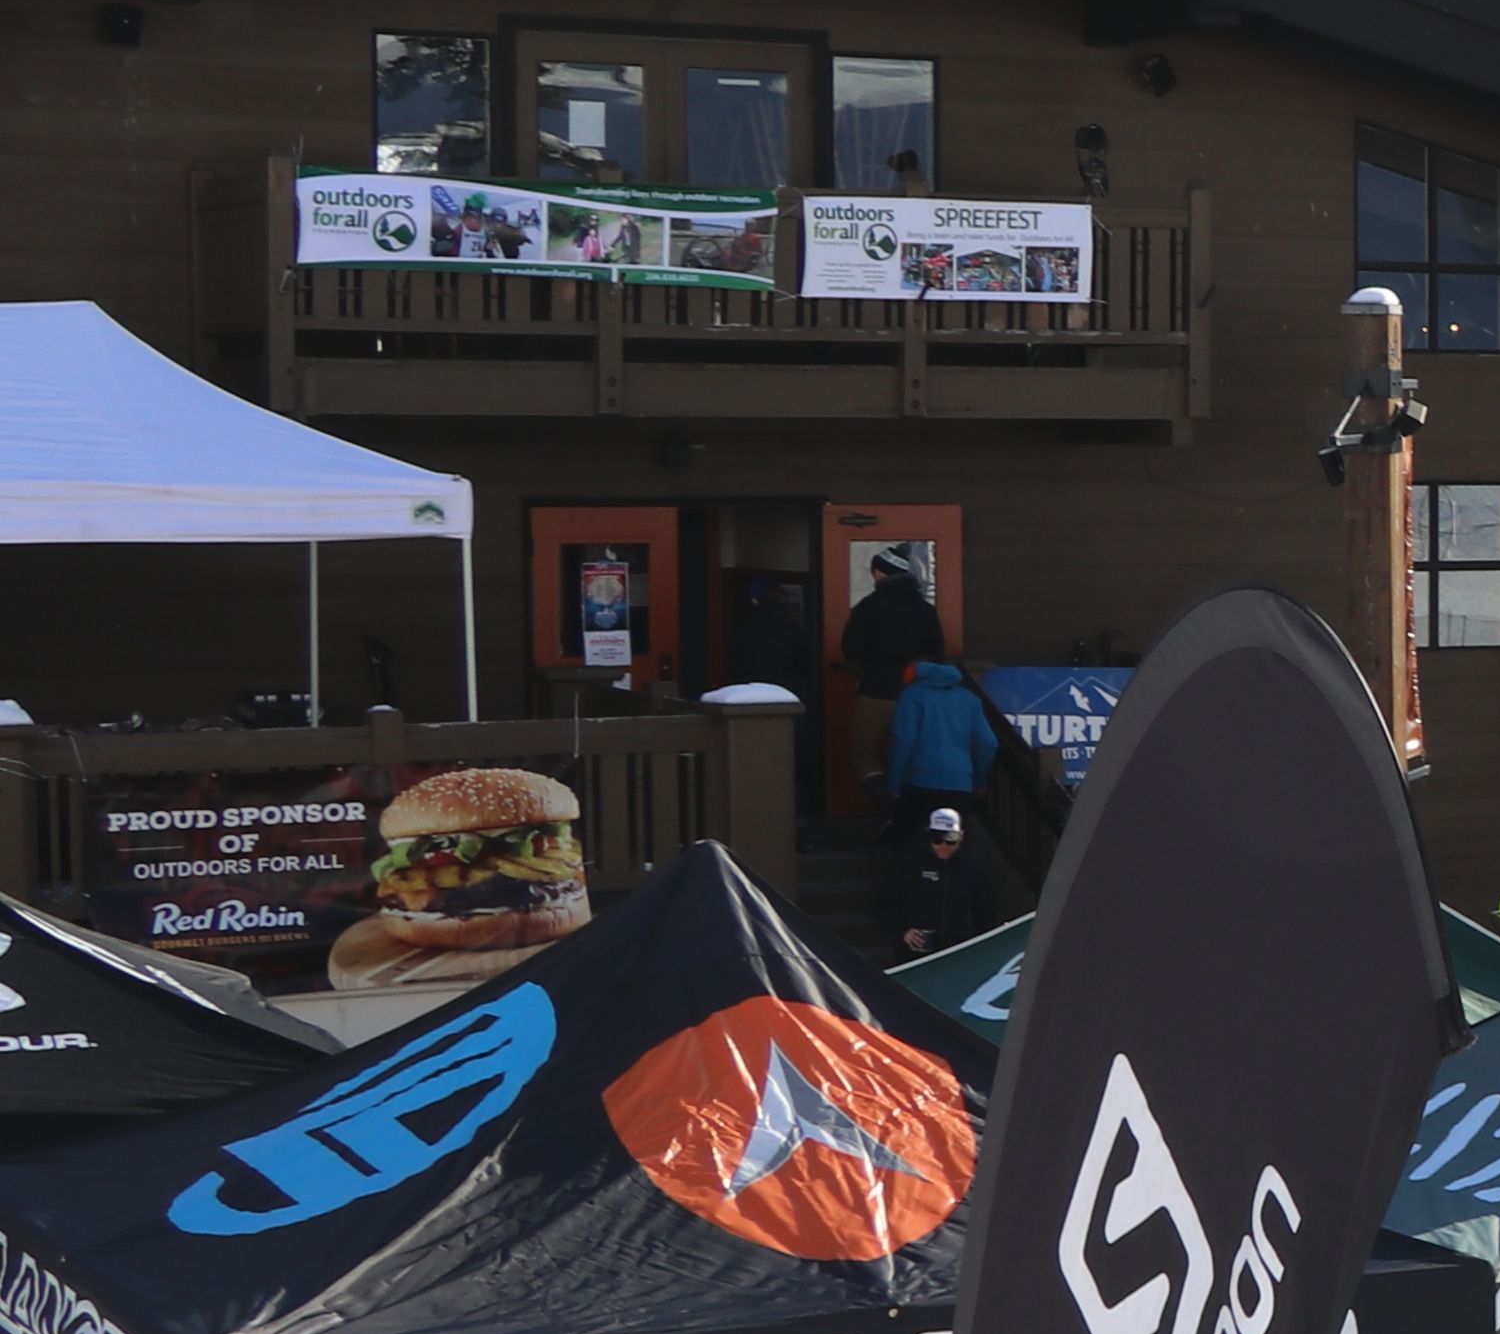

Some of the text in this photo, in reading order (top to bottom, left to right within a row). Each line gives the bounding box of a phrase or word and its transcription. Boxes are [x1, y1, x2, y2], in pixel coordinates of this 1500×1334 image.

[312, 187, 414, 209] outdoors
[813, 202, 894, 222] outdoors
[933, 207, 1042, 231] SPREEFEST
[107, 801, 367, 832] PROUD SPONSOR
[218, 833, 260, 854] OF
[133, 853, 345, 879] OUTDOORS FOR ALL
[152, 898, 306, 935] Red Robin
